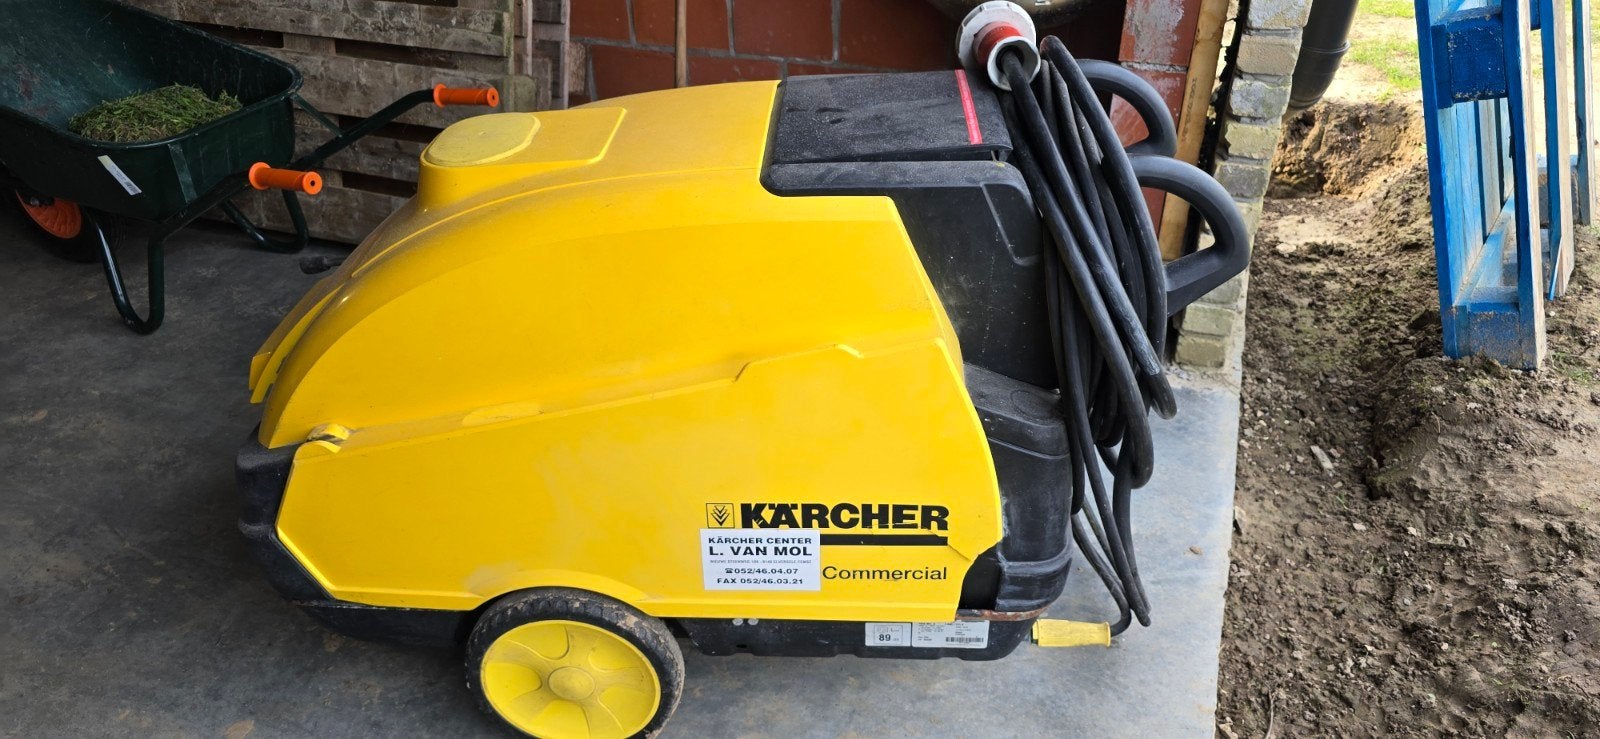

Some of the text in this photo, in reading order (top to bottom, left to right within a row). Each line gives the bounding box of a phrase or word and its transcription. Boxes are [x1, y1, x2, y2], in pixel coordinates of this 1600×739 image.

[741, 503, 949, 530] KÄRCHER
[708, 536, 763, 544] KÄRCHER
[709, 546, 813, 556] L. VAN MOL
[822, 566, 947, 580] Commercial
[878, 633, 891, 641] 89
